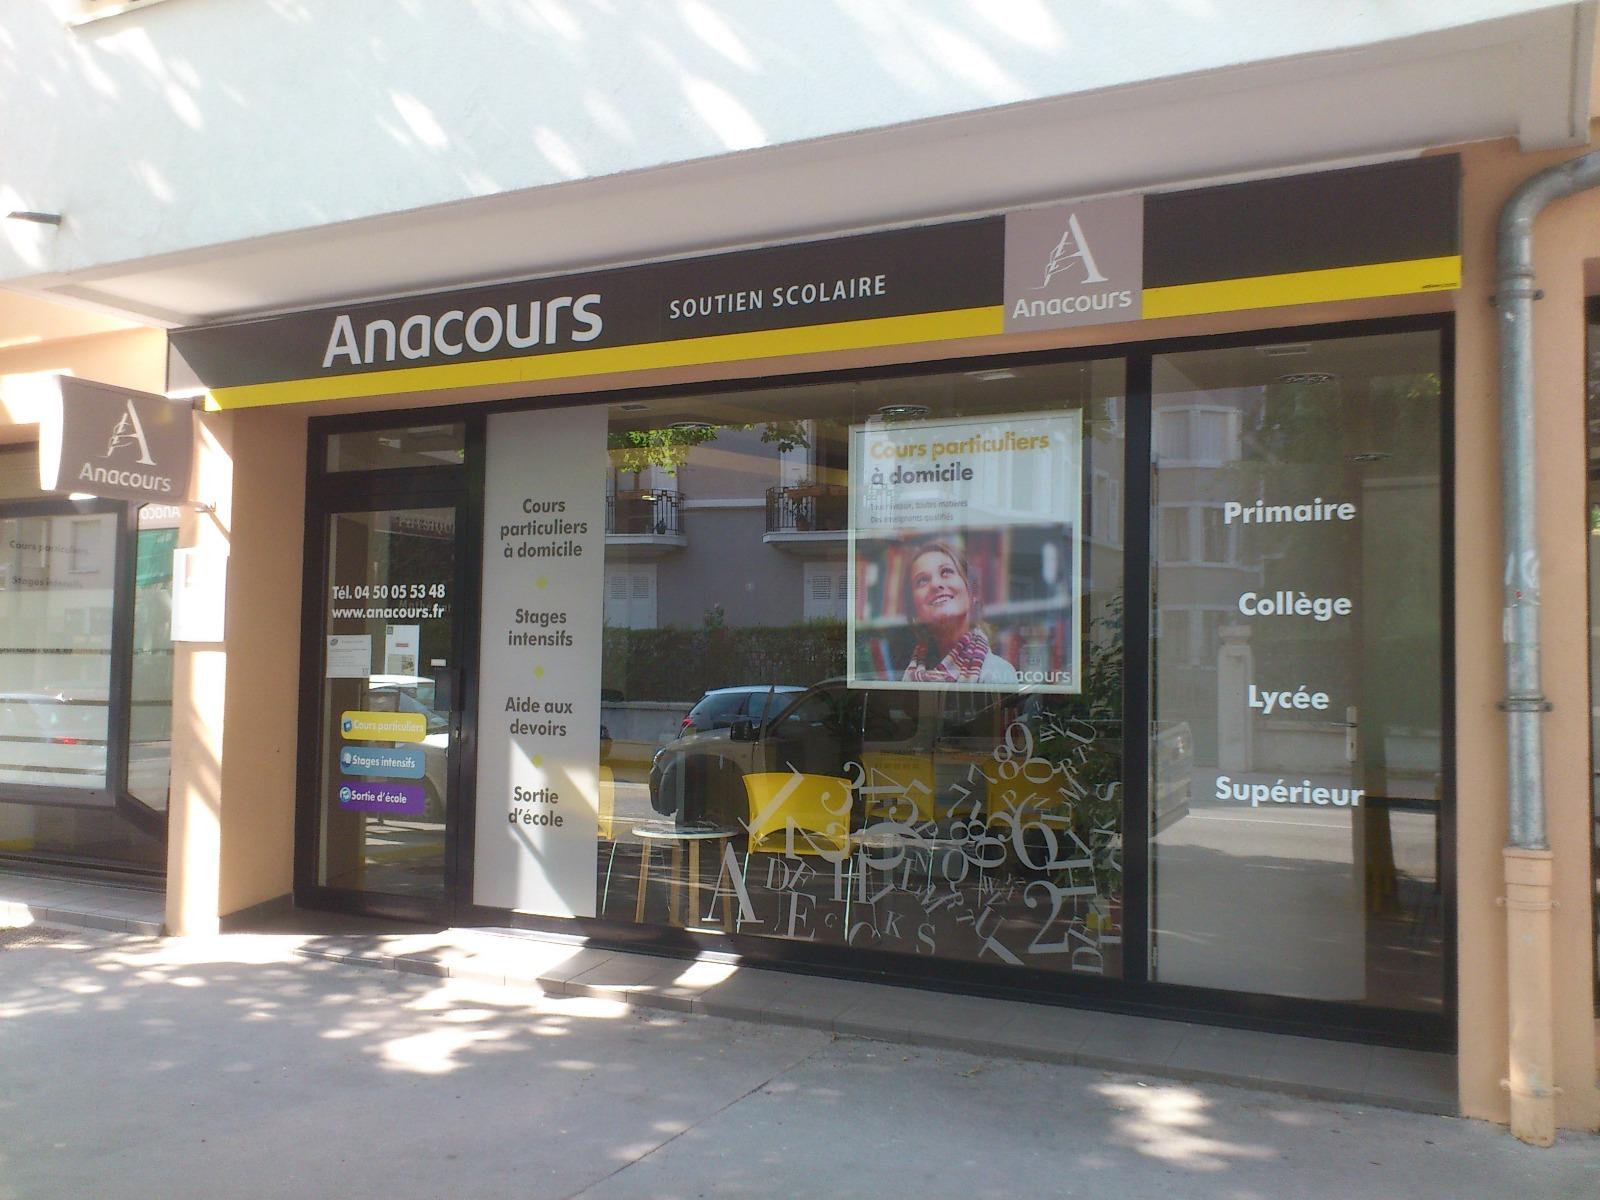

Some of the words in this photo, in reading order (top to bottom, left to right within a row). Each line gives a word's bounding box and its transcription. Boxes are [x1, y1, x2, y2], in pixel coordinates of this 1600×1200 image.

[669, 289, 763, 319] SOUTIEN
[772, 274, 886, 307] SCOLAIRE
[1012, 290, 1132, 319] Anacours
[322, 294, 603, 368] Anacours
[869, 440, 927, 460] Cours
[931, 431, 1049, 461] particuliers
[78, 462, 172, 492] Anacours
[889, 461, 974, 484] domicile
[523, 498, 566, 514] Cours
[1224, 498, 1356, 524] Primaire
[500, 519, 588, 540] particuliers
[504, 543, 513, 558] à
[517, 541, 582, 558] domicile
[332, 585, 352, 599] Tél.
[354, 585, 370, 600] 04
[373, 585, 388, 599] 50
[391, 585, 407, 599] 05
[410, 585, 426, 599] 53
[429, 584, 445, 598] 48
[331, 603, 445, 618] www.anacours.fr
[1239, 591, 1352, 621] Collège
[515, 608, 567, 627] Stages
[508, 630, 573, 646] intensifs
[505, 696, 540, 713] Aide
[544, 701, 573, 714] aux
[1248, 685, 1330, 714] Lycée
[353, 720, 376, 730] Cours
[379, 720, 424, 733] particuliers
[510, 719, 567, 736] devoirs
[352, 755, 379, 768] Stages
[381, 756, 416, 768] intensifs
[351, 790, 375, 802] Sortie
[513, 786, 559, 804] Sortie
[1215, 776, 1365, 808] Supérieur
